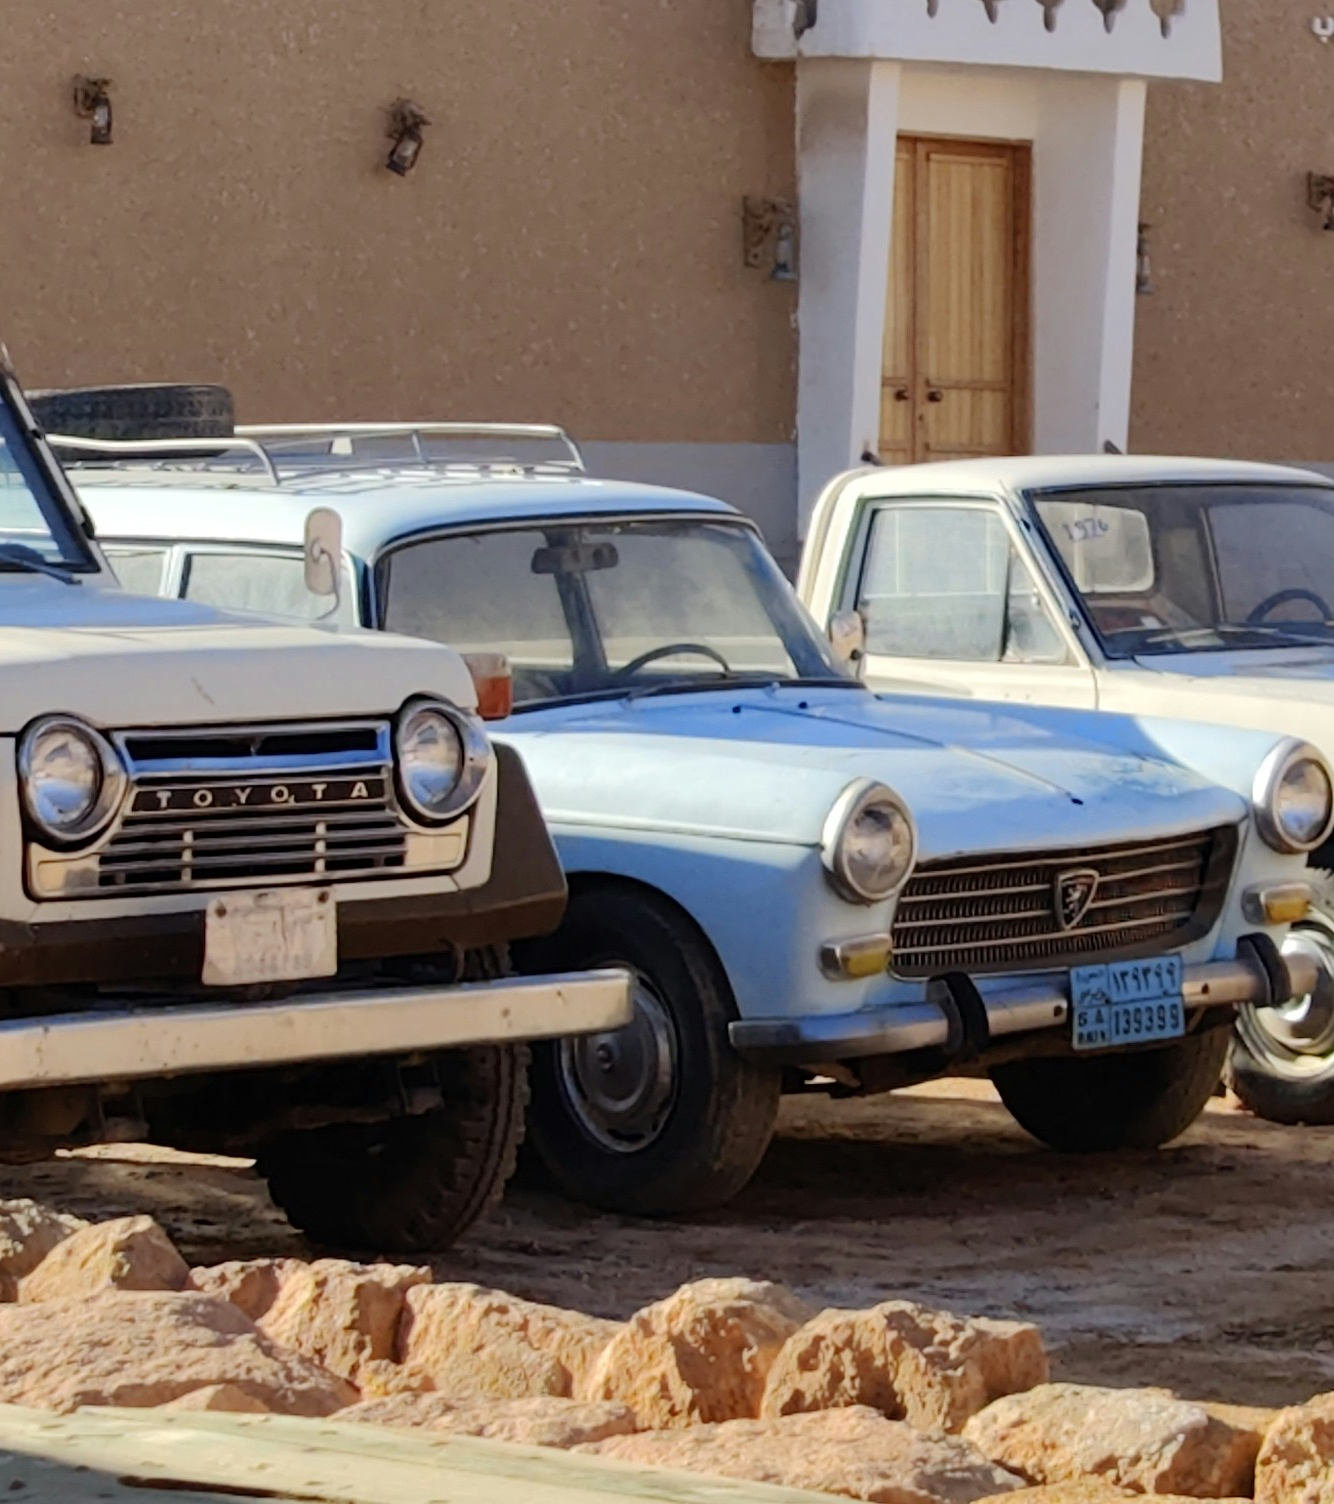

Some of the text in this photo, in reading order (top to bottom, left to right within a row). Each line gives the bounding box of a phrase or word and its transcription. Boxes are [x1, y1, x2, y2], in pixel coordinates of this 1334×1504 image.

[156, 781, 369, 808] TOYOTA
[1112, 961, 1177, 994] ١٣٩٣٩٩
[1113, 1003, 1181, 1036] 139399
